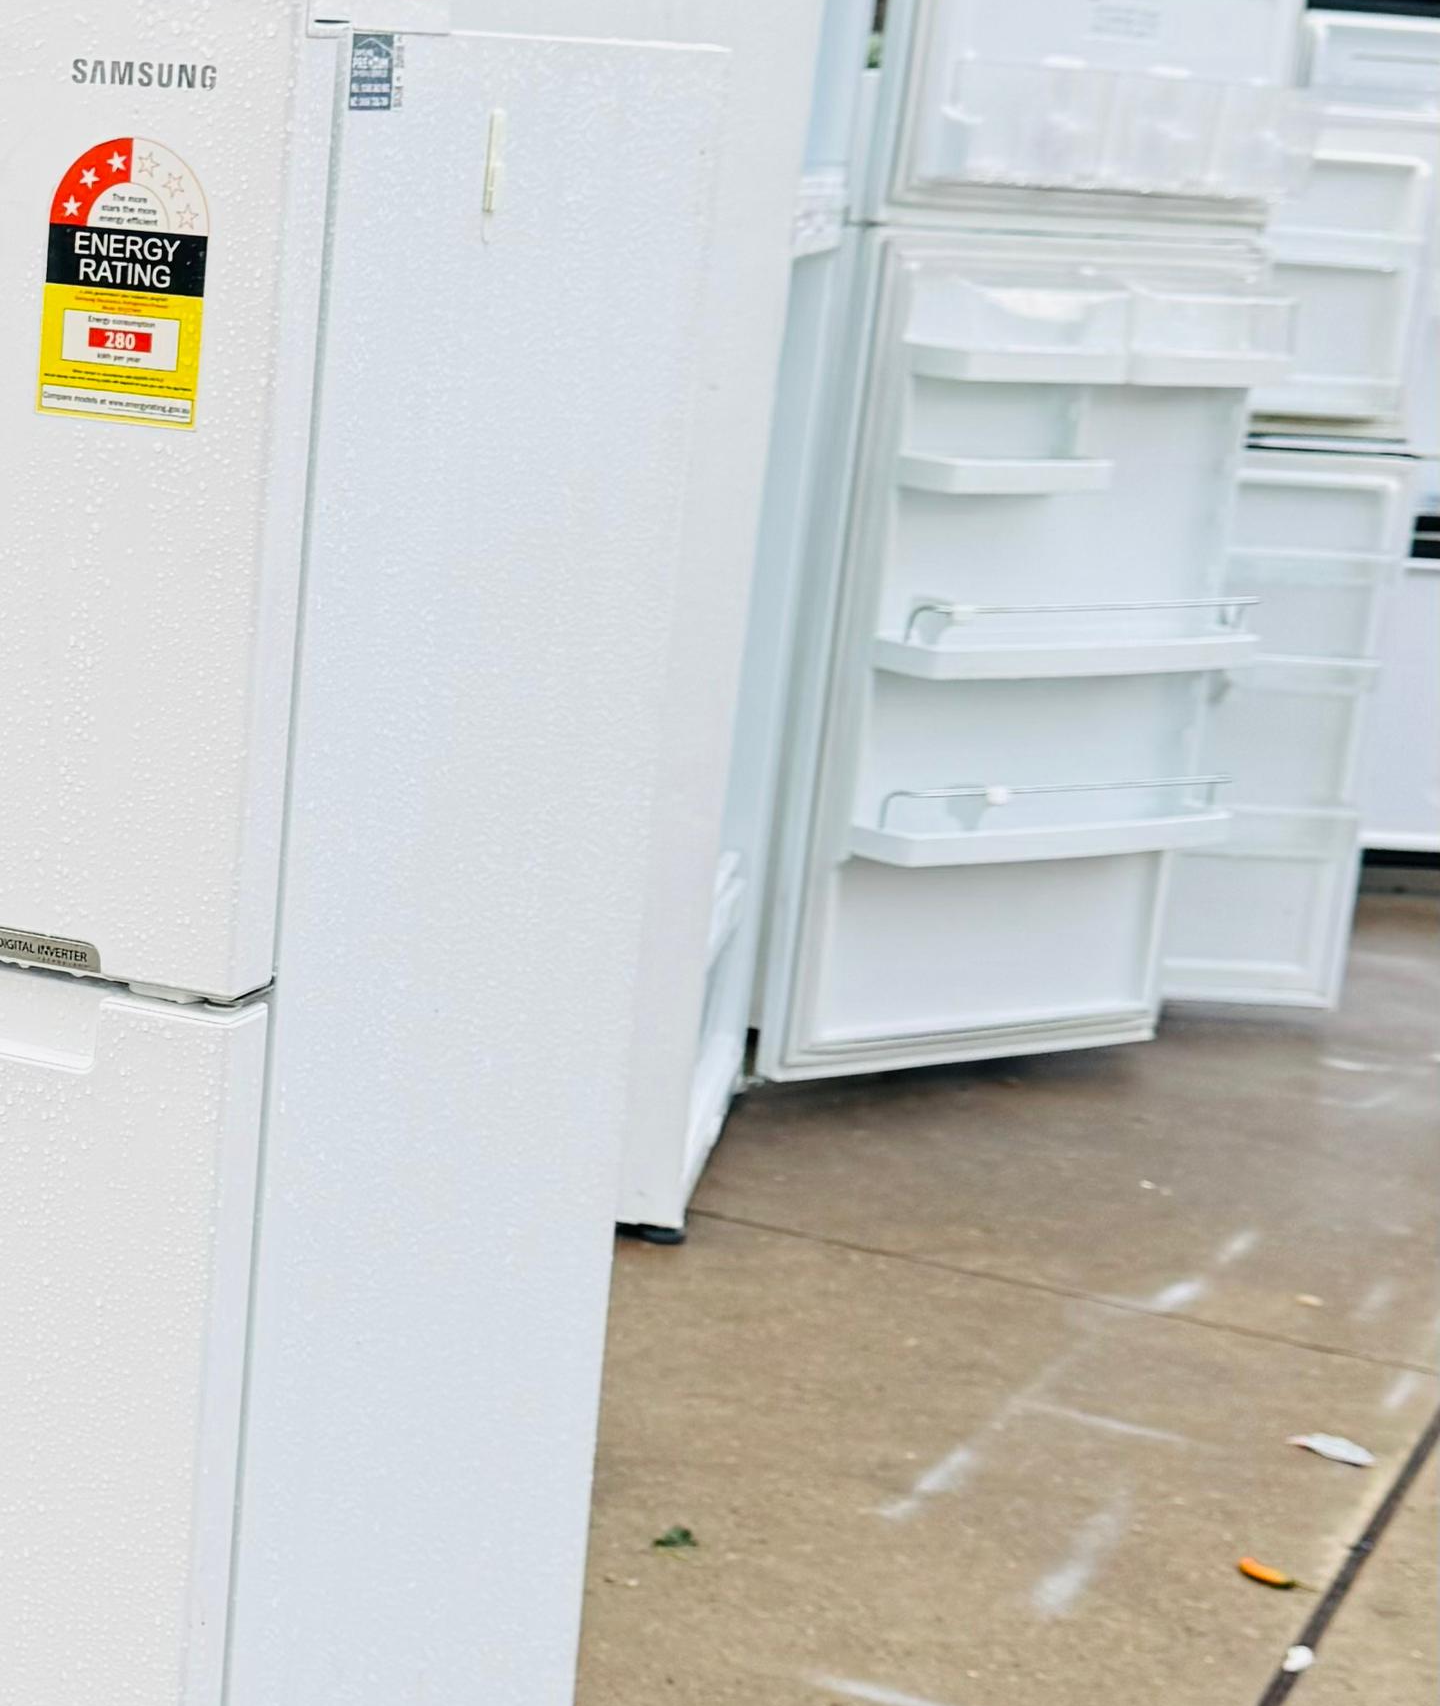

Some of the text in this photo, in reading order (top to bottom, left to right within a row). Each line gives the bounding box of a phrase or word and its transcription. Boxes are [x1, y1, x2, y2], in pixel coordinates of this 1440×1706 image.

[71, 58, 218, 91] SAMSUNG
[74, 231, 181, 263] ENERGY
[79, 258, 172, 288] RATING
[103, 330, 136, 350] 280
[37, 944, 88, 963] INVERTER
